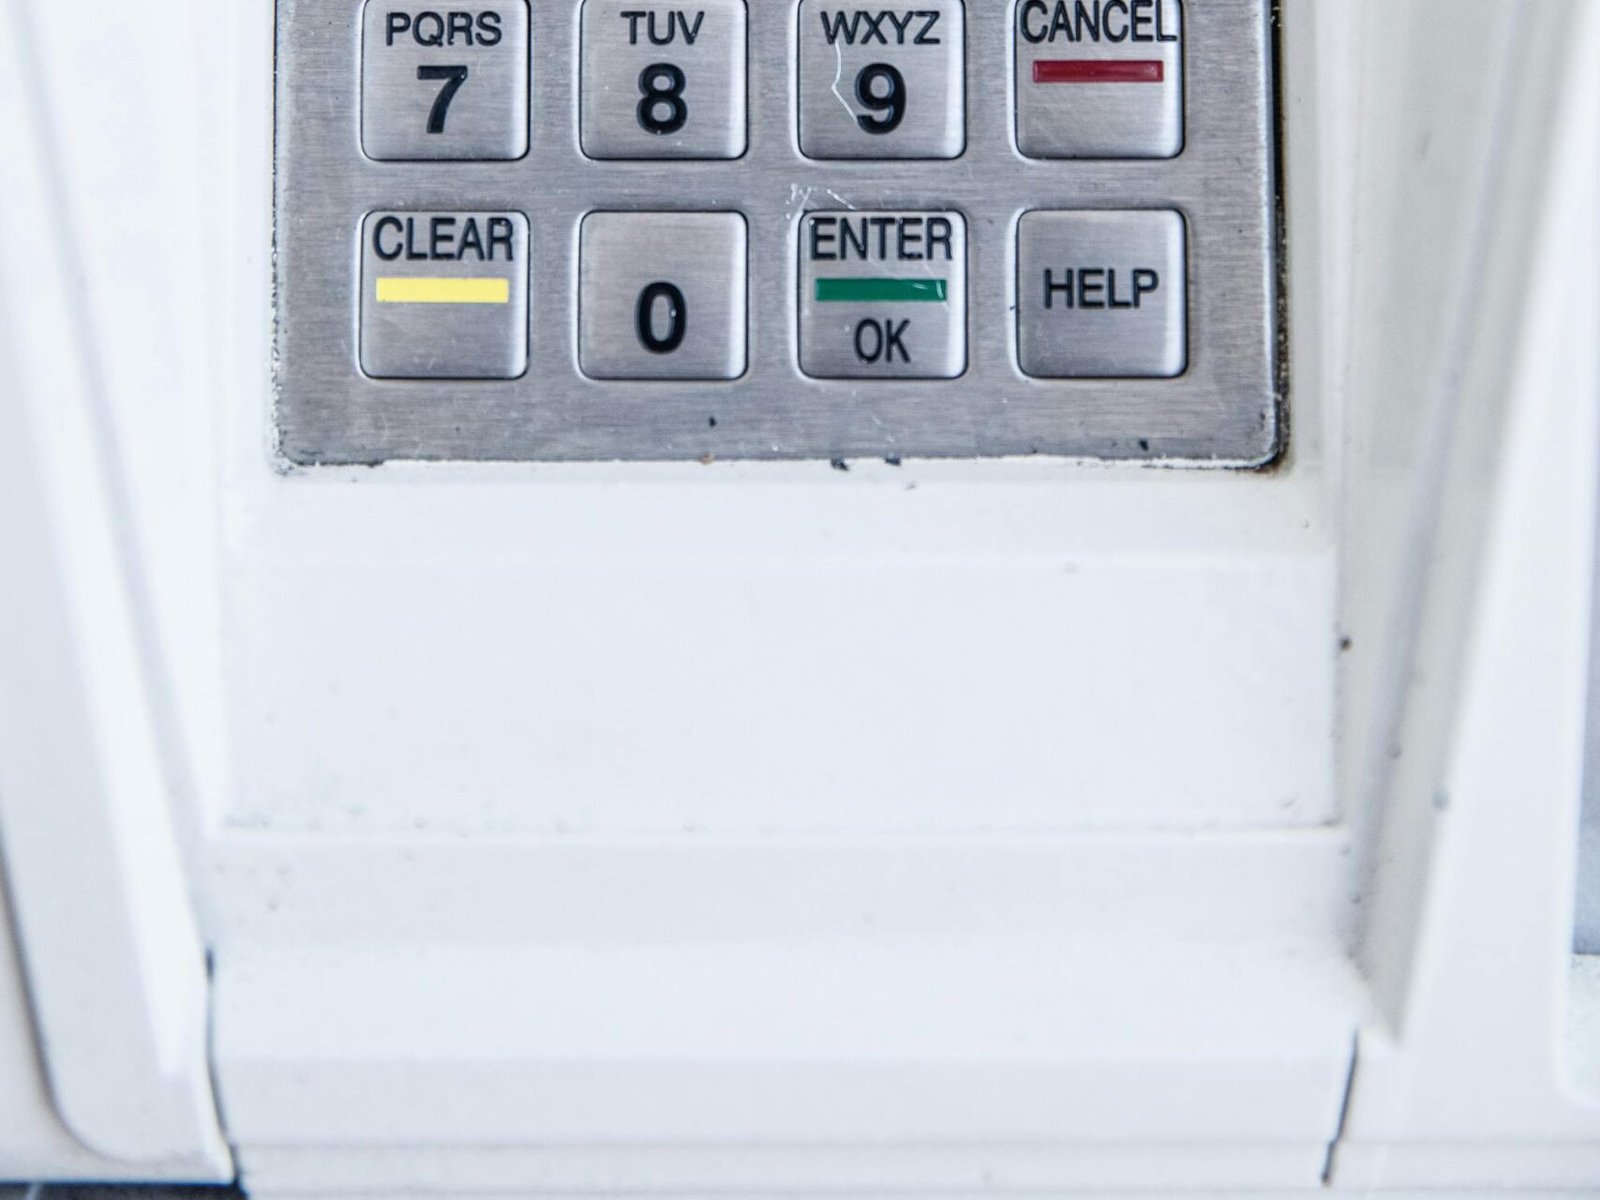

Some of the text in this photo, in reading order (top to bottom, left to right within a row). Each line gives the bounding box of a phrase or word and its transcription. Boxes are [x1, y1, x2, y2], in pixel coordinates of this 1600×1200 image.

[386, 10, 502, 48] PQRS
[620, 10, 705, 46] TUV
[820, 10, 941, 45] WXYZ
[417, 65, 468, 134] 7
[636, 62, 688, 136] 8
[854, 62, 907, 136] 9
[373, 215, 514, 262] CLEAR
[810, 216, 953, 261] ENTER
[1043, 267, 1159, 310] HELP
[635, 281, 687, 355] 0
[853, 317, 911, 365] OK
